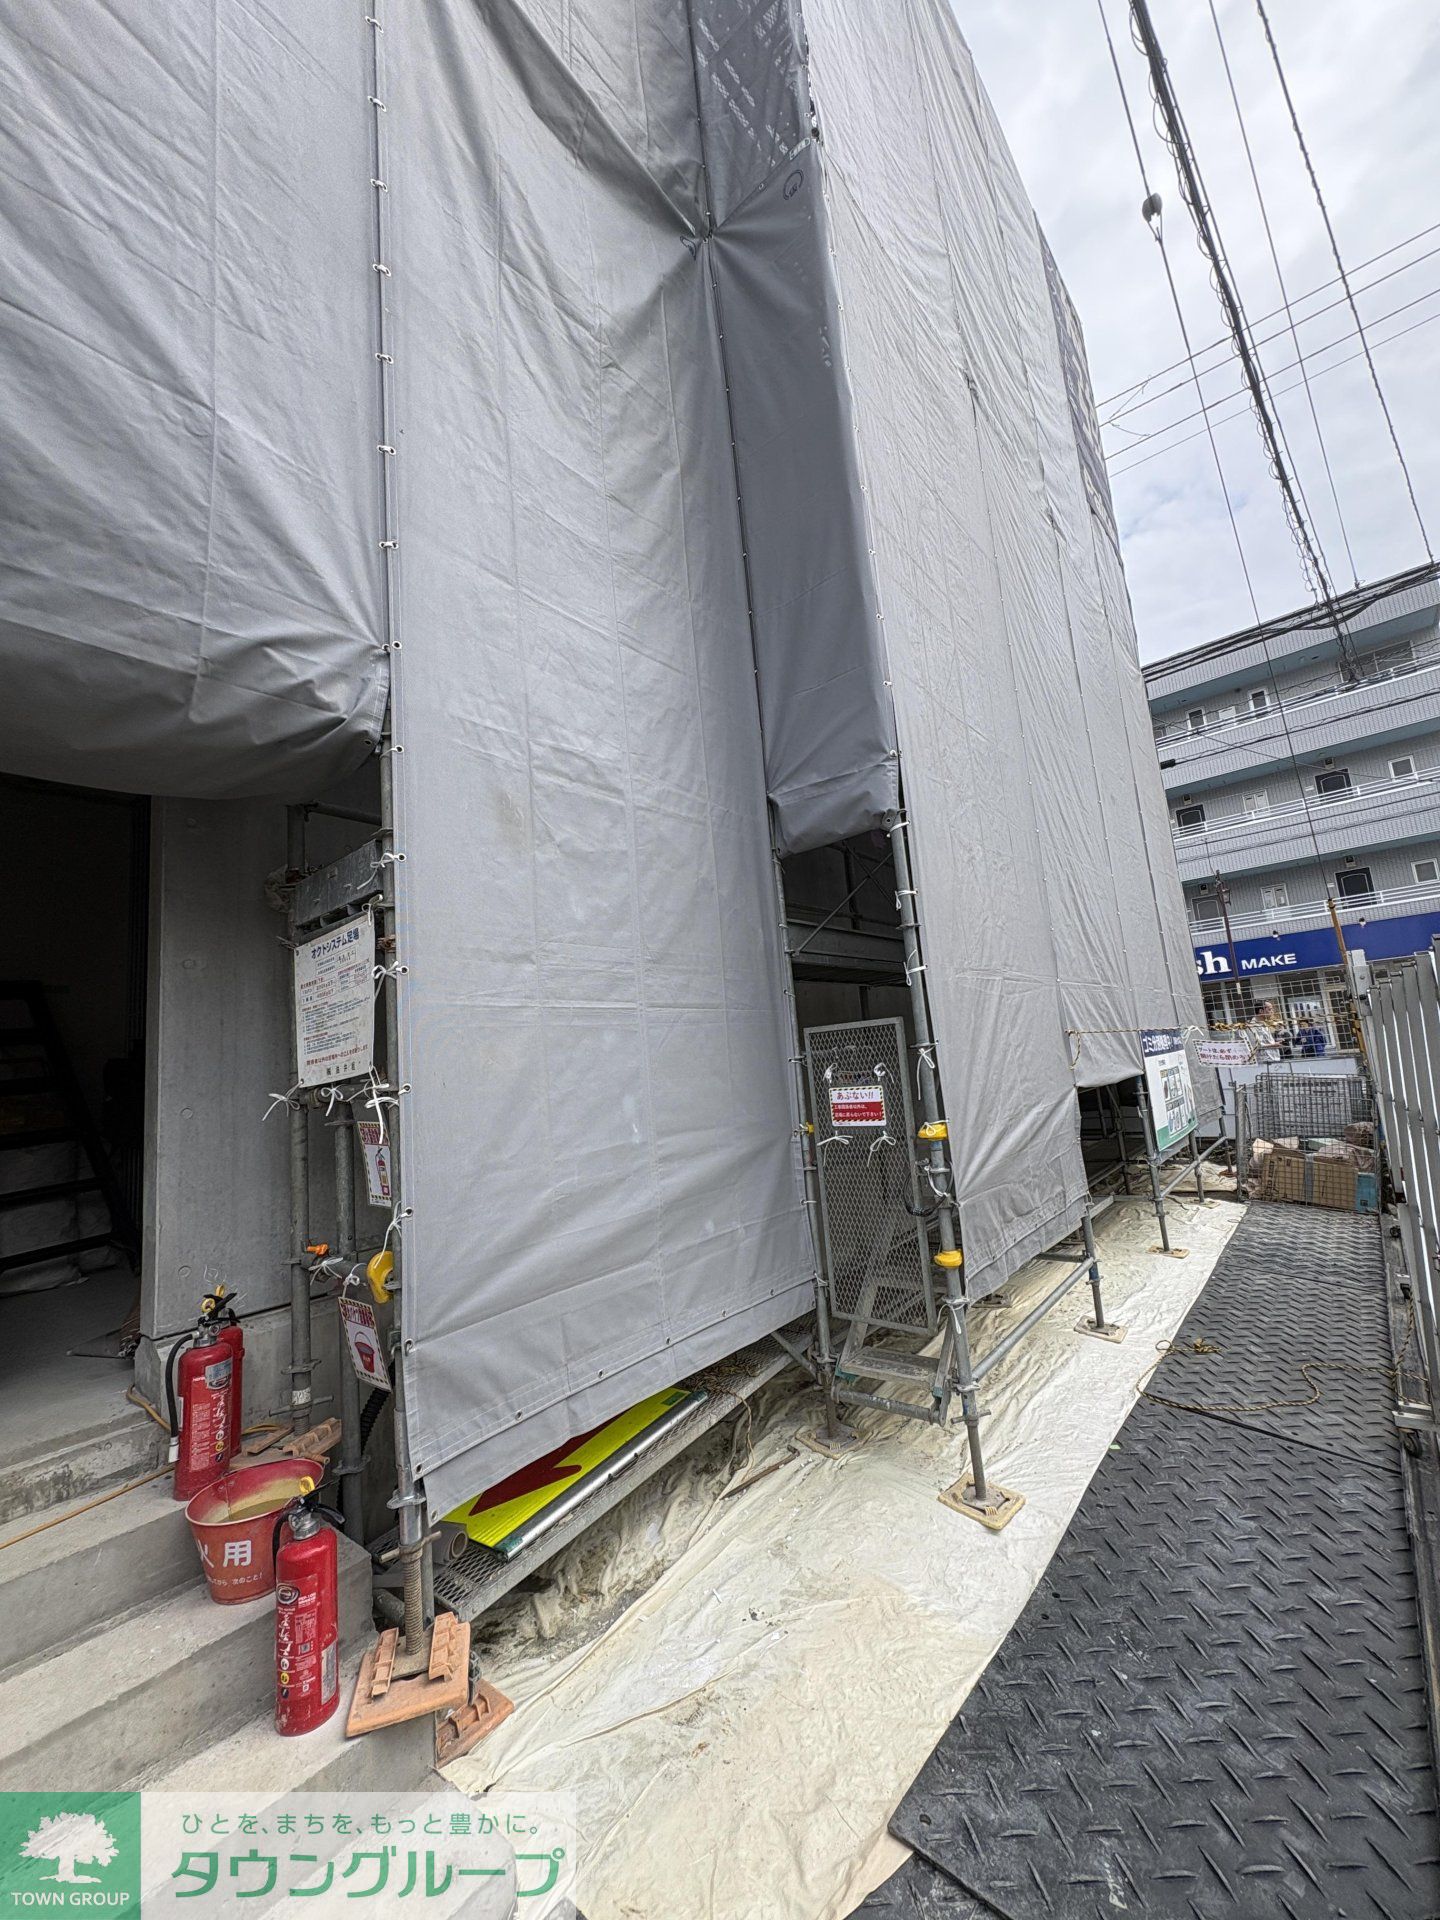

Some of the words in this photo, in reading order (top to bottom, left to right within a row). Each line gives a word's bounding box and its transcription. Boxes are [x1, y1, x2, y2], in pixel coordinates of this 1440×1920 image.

[311, 927, 359, 960] オクトシステム足場
[1241, 953, 1297, 970] MAKE
[836, 1091, 874, 1101] あぶない!!
